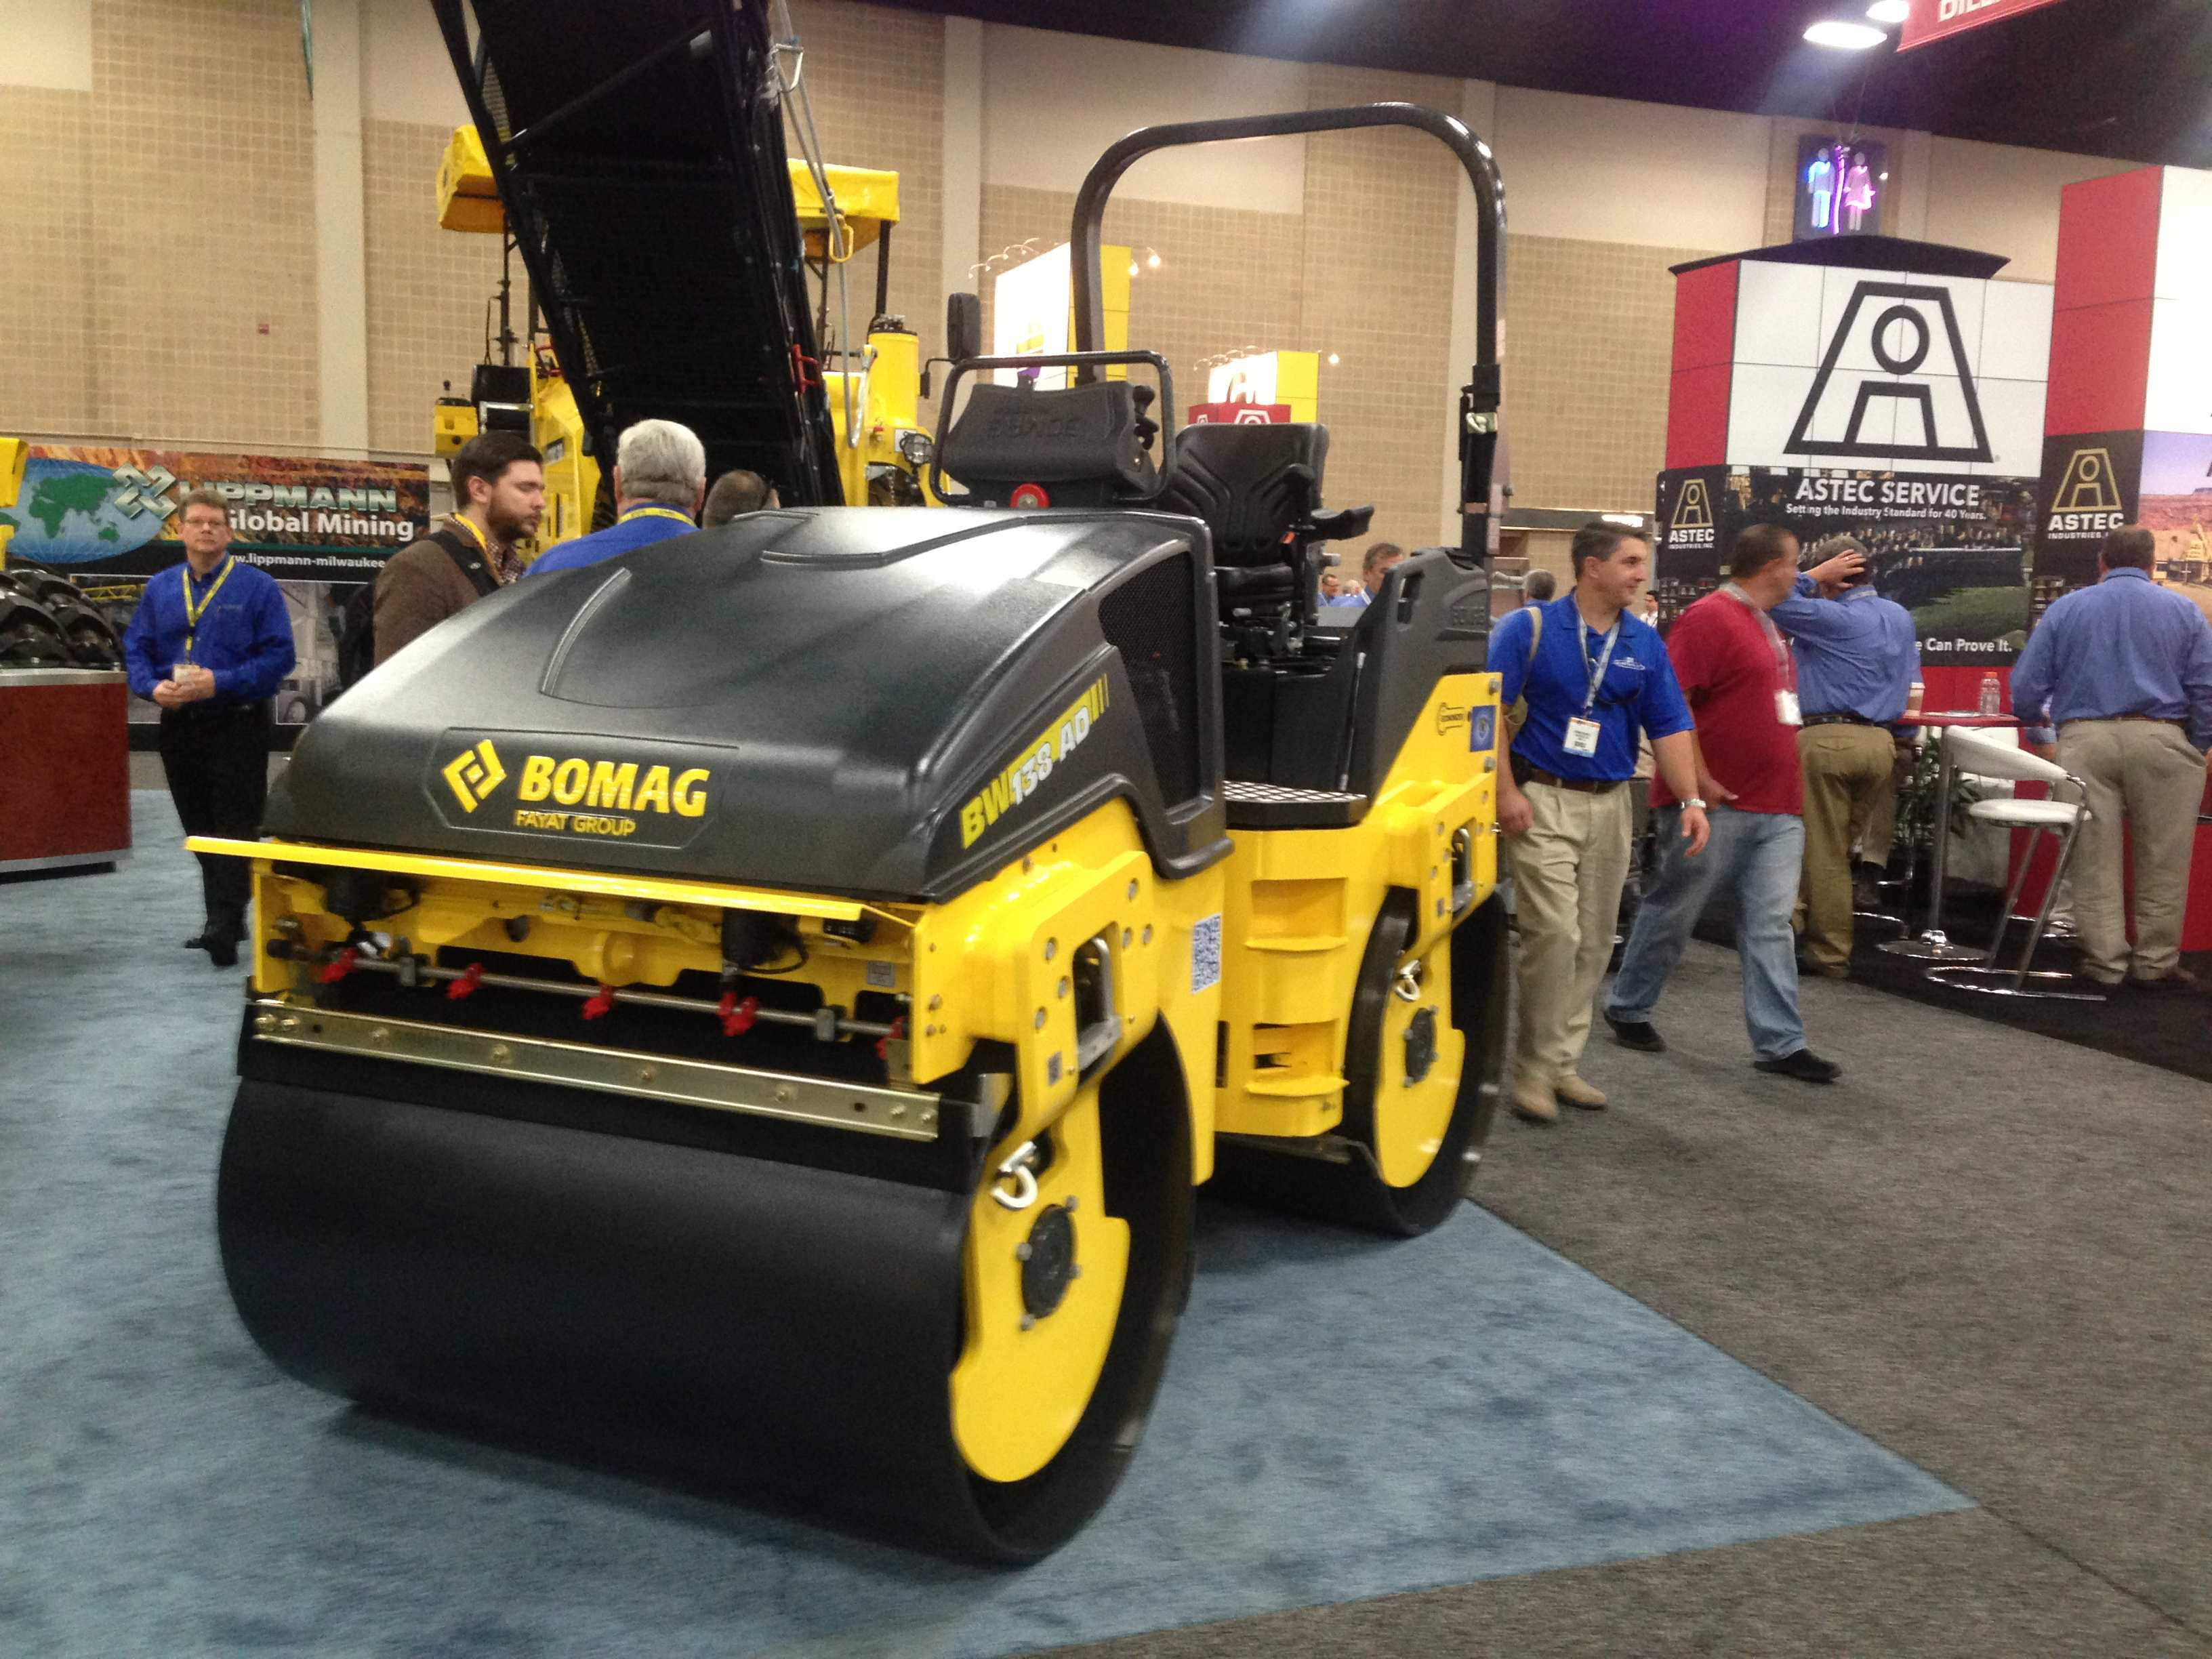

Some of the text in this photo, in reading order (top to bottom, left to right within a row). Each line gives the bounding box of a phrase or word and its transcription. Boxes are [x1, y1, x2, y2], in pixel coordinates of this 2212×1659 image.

[1796, 478, 1980, 506] ASTEC SERVICE
[1823, 505, 1839, 515] the
[1842, 506, 1881, 519] Industry
[1884, 506, 1926, 517] Standard
[1929, 508, 1942, 518] for
[1944, 509, 1957, 518] 40
[2048, 512, 2124, 531] ASTEC
[318, 512, 413, 542] Mining
[1669, 529, 1715, 543] ASTEC
[1926, 637, 1952, 651] Can
[1956, 638, 1995, 652] Prove
[1999, 638, 2013, 652] It.
[1059, 705, 1090, 762] AD
[518, 755, 710, 817] BOMAG
[514, 809, 636, 836] FAYAT GROUP
